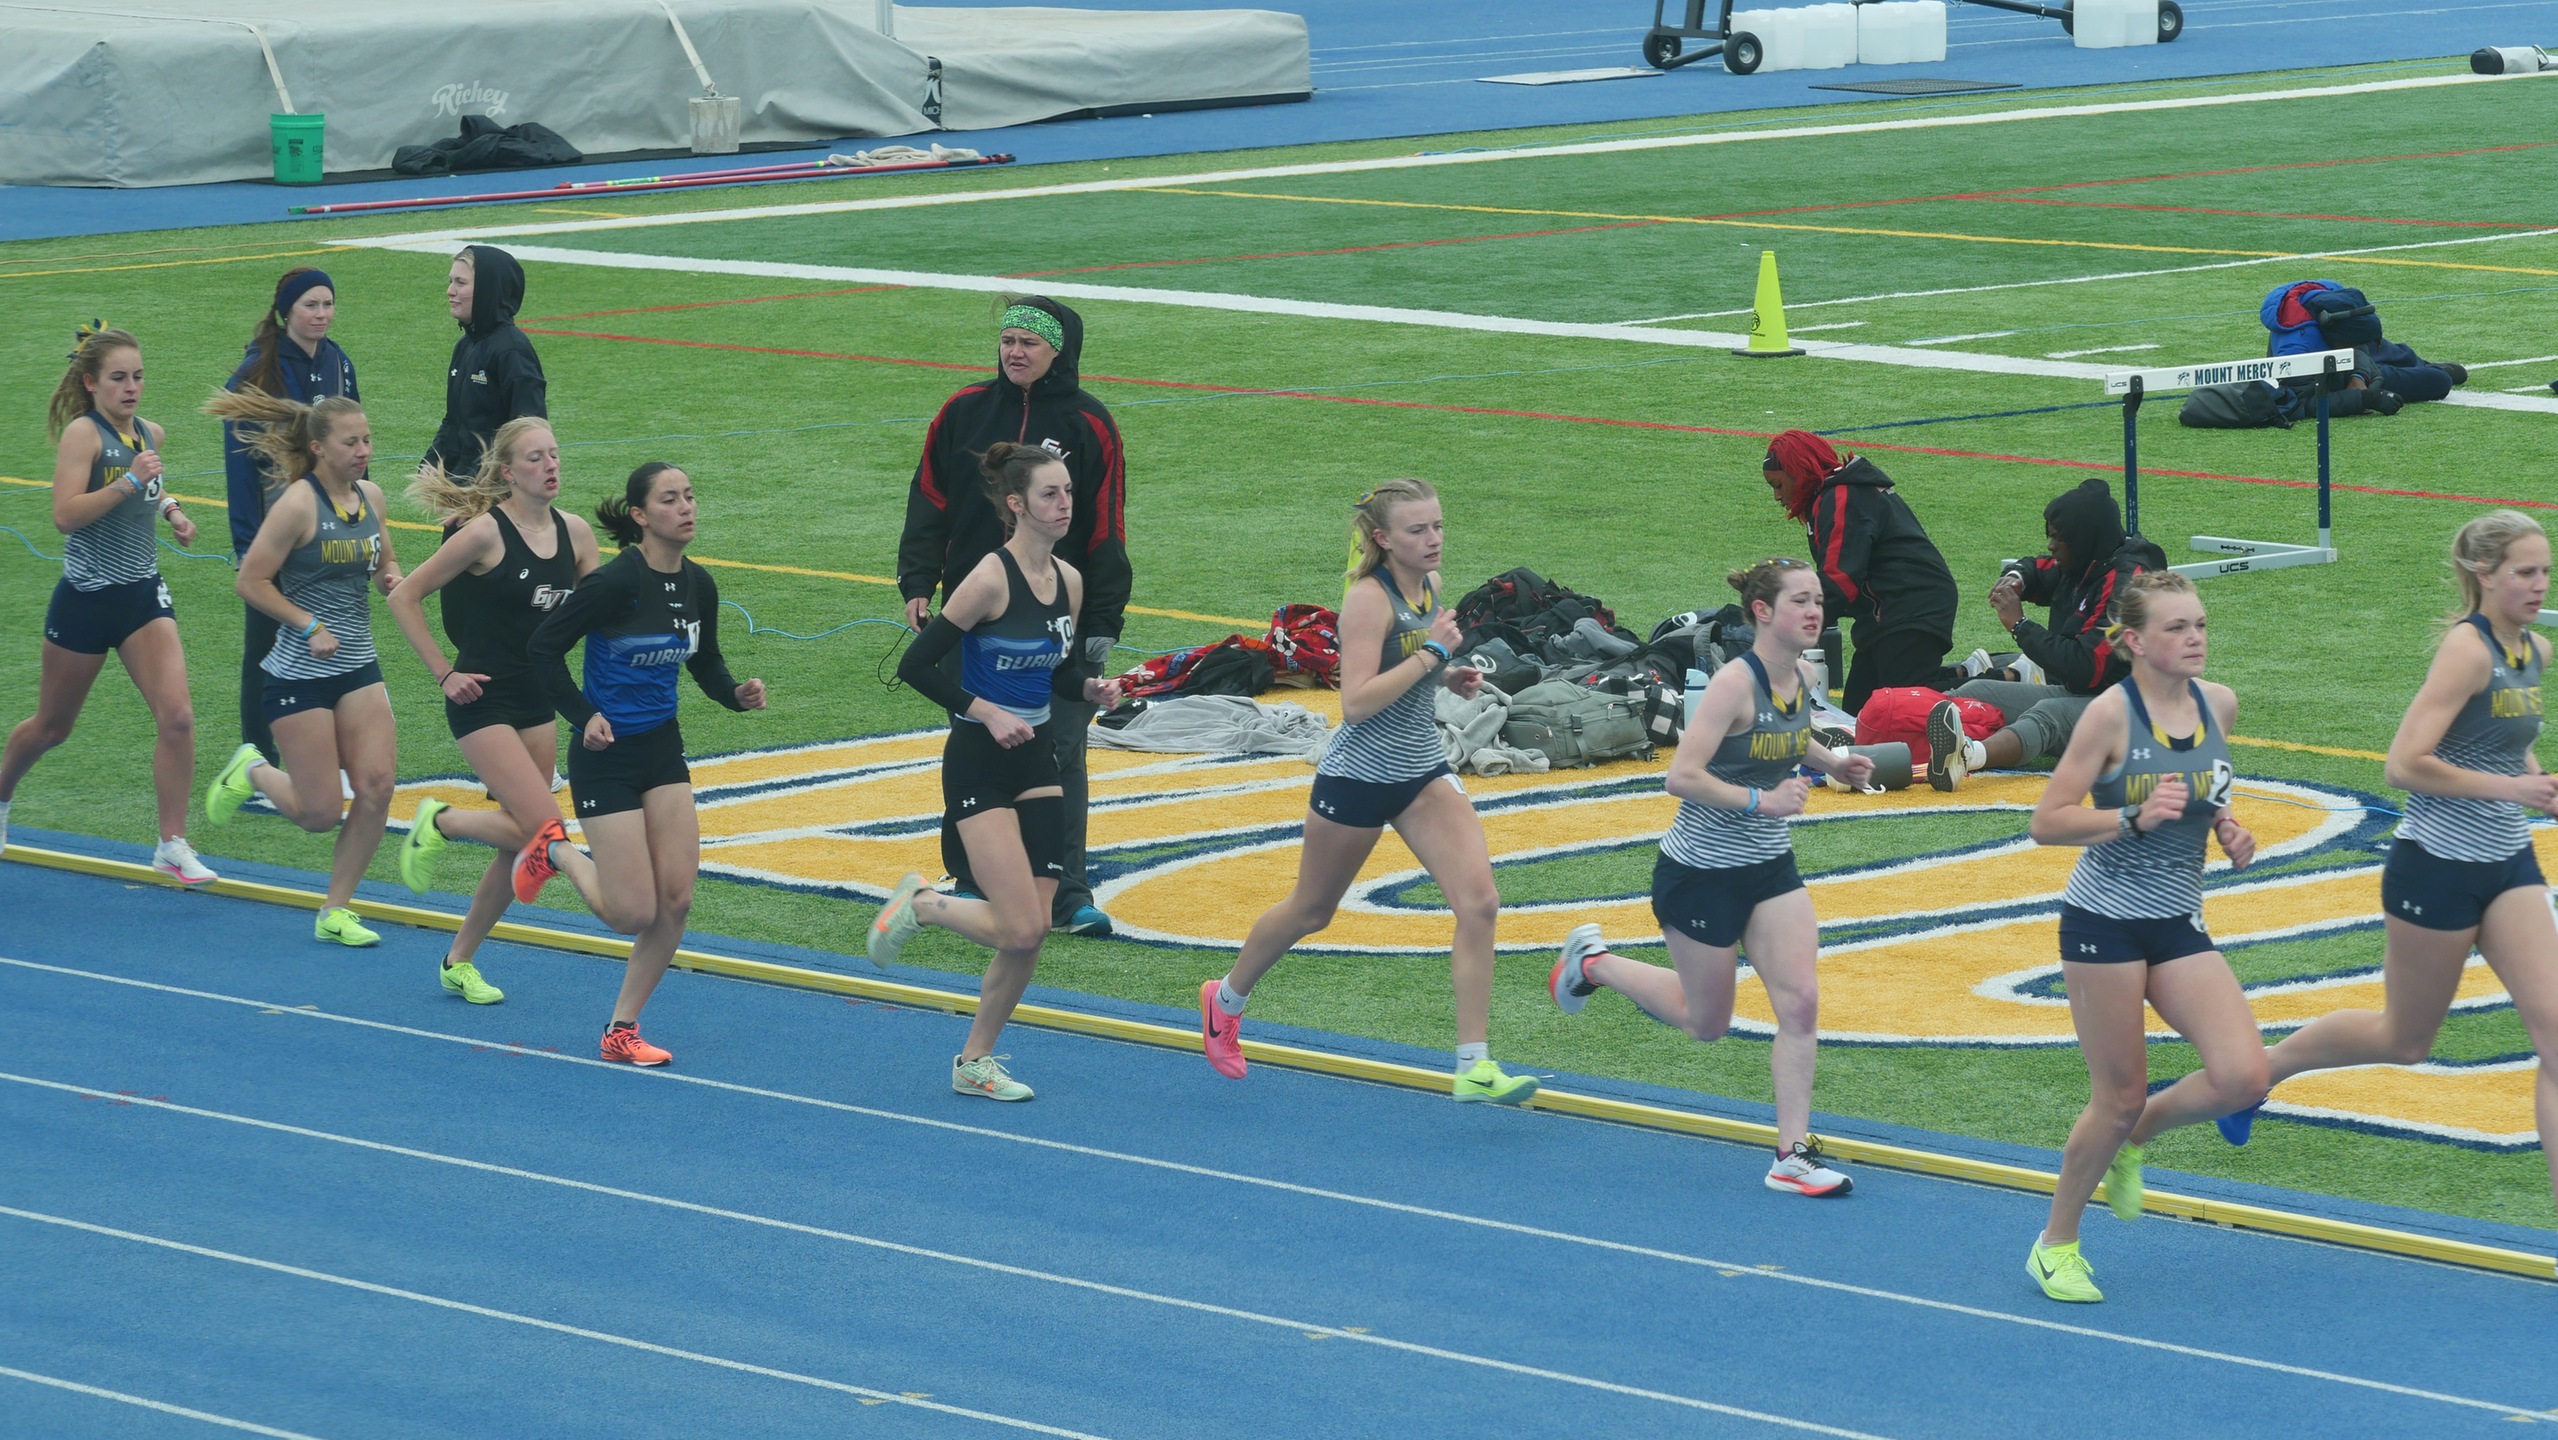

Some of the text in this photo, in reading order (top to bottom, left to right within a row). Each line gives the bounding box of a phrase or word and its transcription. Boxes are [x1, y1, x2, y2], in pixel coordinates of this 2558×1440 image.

[432, 80, 509, 119] Richey
[2195, 362, 2274, 386] MOUNT MERCY
[321, 539, 357, 564] MOUNT
[2219, 561, 2249, 573] UCS
[1749, 731, 1792, 760] MOUNT
[2214, 764, 2231, 805] 2
